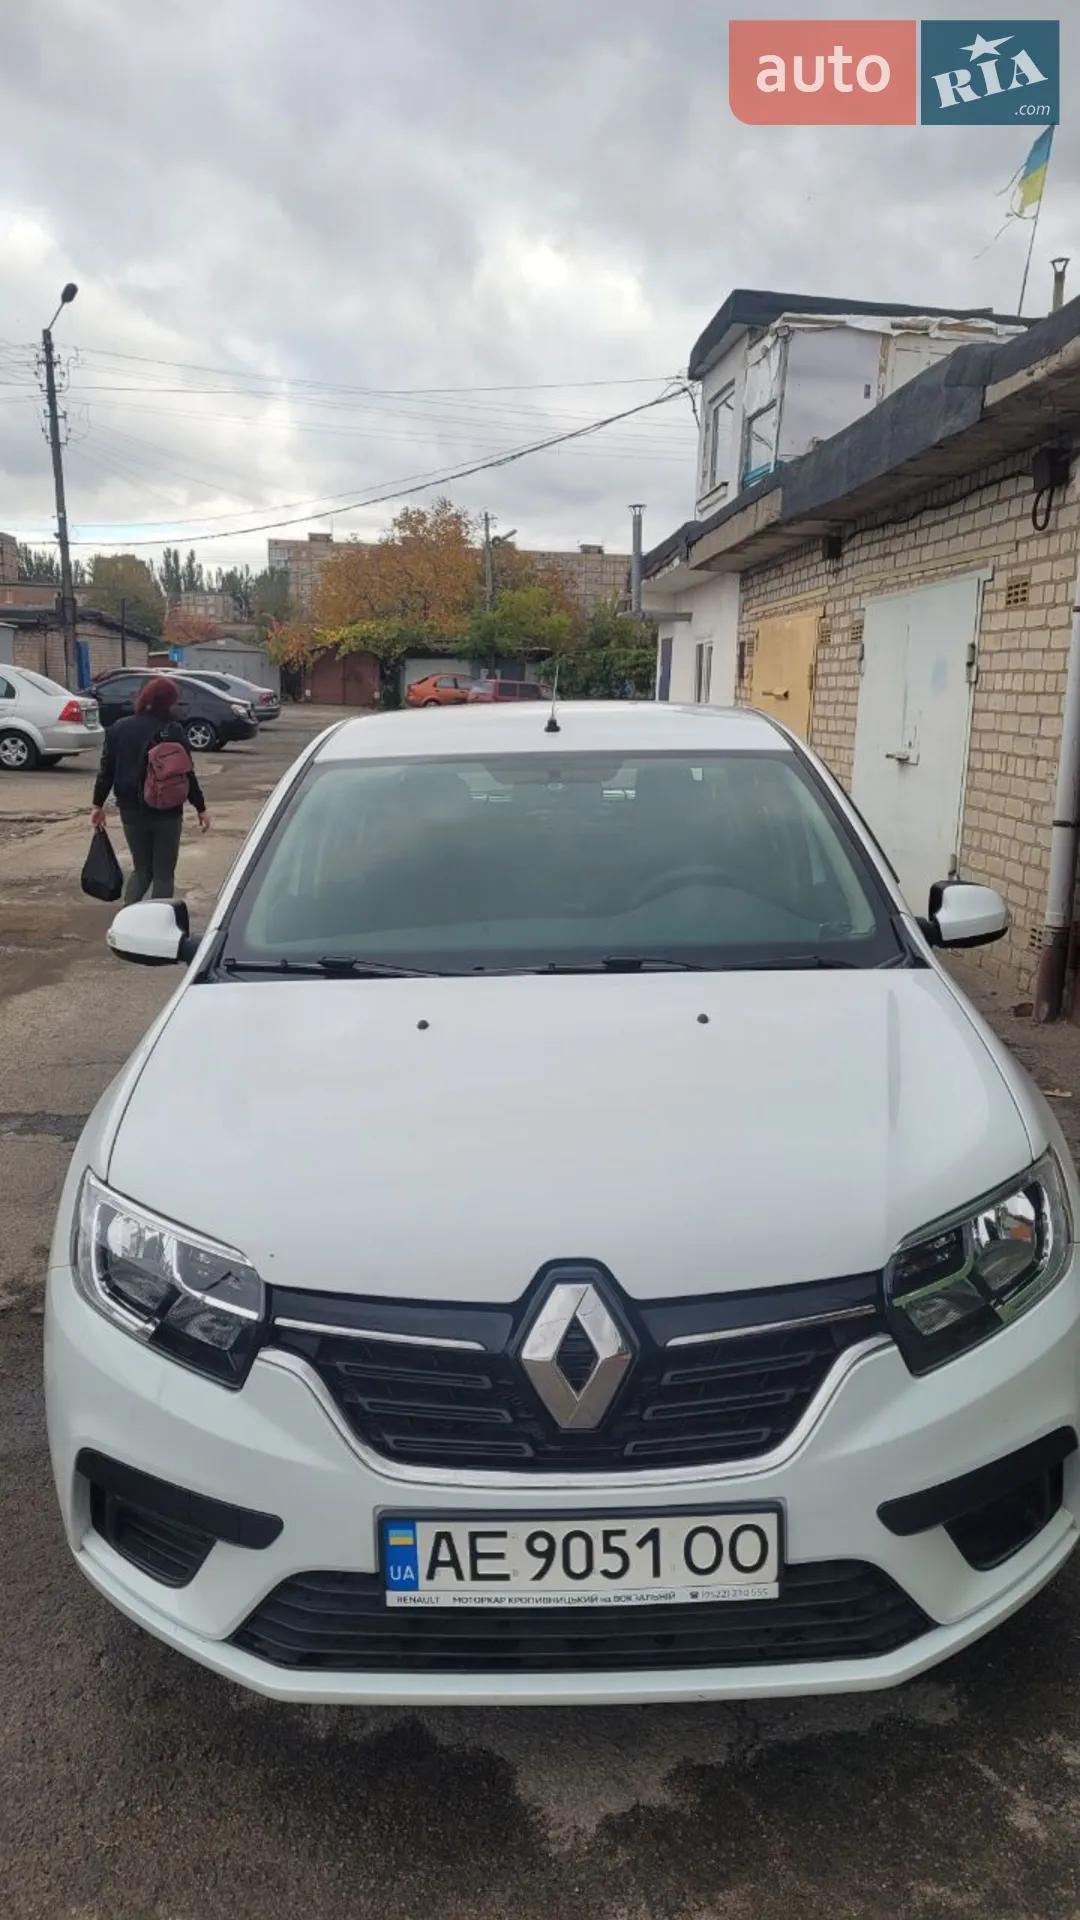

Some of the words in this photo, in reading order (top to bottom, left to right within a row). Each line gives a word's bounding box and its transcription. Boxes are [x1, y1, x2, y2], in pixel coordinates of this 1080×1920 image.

[425, 1530, 511, 1582] AE
[524, 1527, 662, 1582] 9051
[683, 1523, 769, 1576] OO
[389, 1565, 416, 1582] UA
[396, 1595, 440, 1605] RENAULT
[452, 1596, 506, 1605] МОТОРКАР
[507, 1594, 599, 1605] КРОПИВНИЦЬКИЙ
